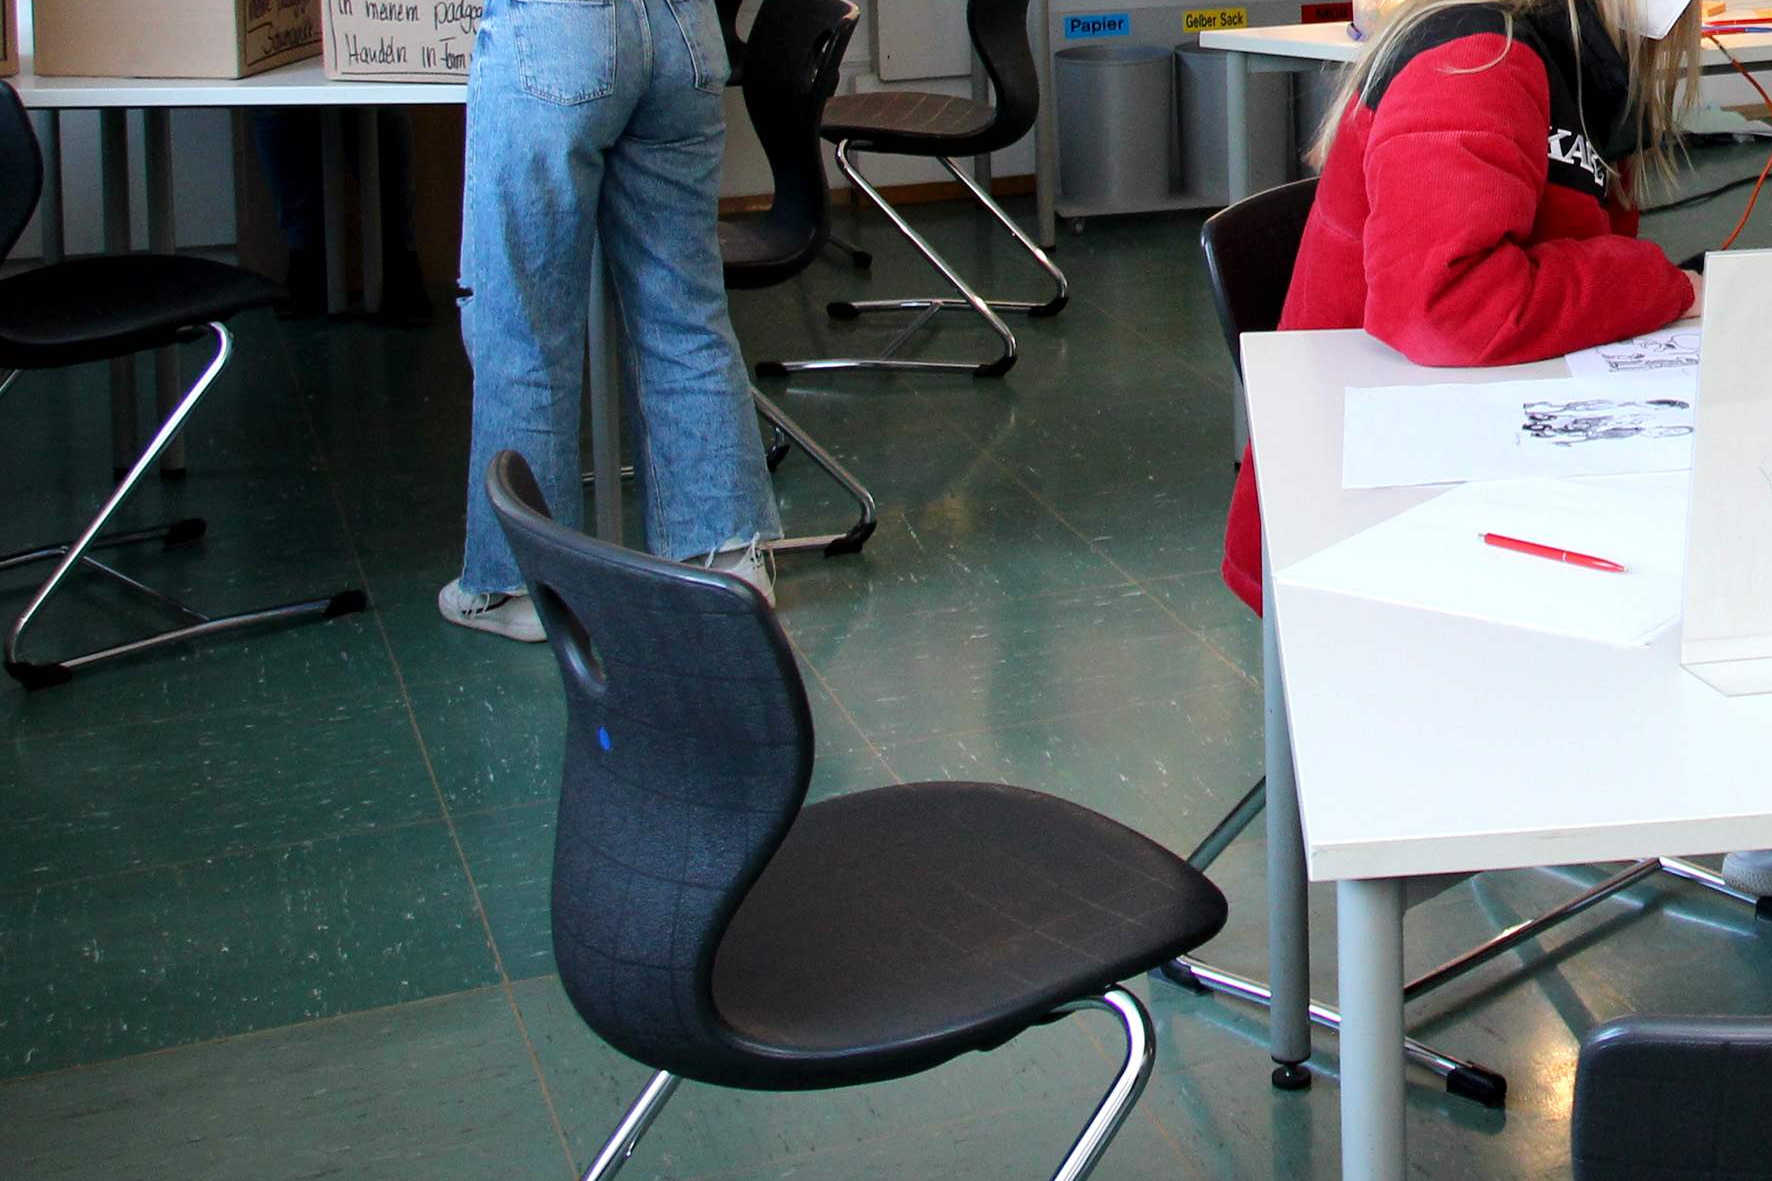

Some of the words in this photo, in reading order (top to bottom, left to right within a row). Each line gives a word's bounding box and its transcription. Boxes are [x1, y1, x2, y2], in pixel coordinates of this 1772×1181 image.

[1070, 16, 1124, 35] Papier
[1186, 14, 1216, 28] Gelber
[1220, 11, 1243, 26] Sack
